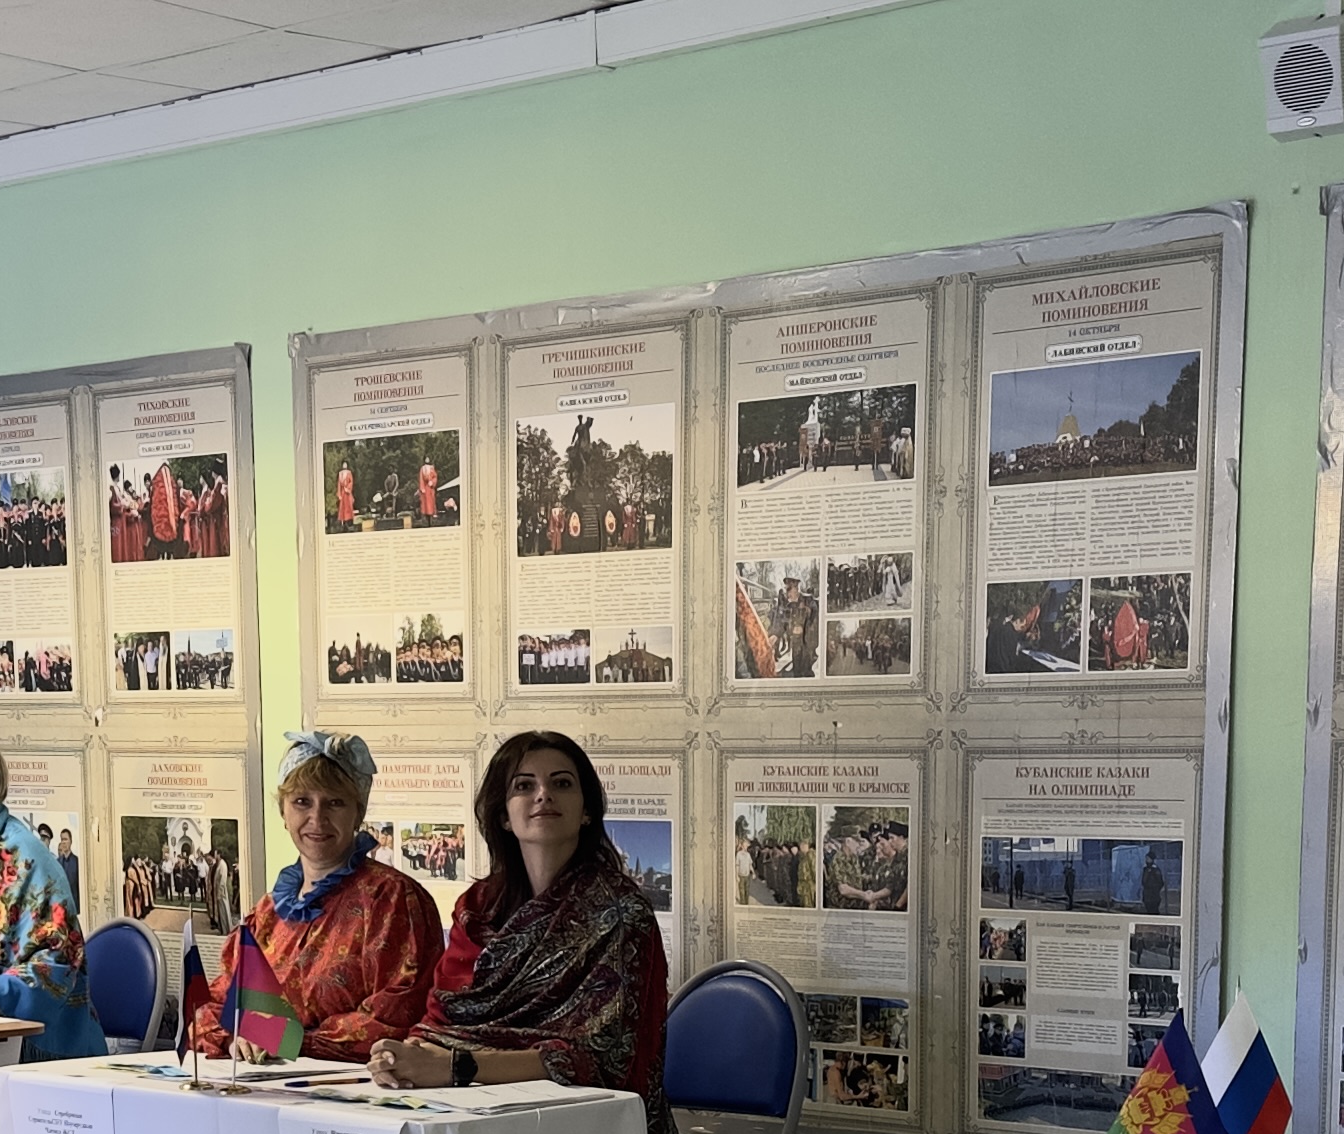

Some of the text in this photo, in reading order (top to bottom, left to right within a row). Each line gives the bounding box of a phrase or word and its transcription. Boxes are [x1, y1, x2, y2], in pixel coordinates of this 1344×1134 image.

[1032, 278, 1161, 306] МИХАЙЛОВСКИЕ
[1042, 299, 1149, 323] ПОМИНОВЕНИЯ
[776, 315, 878, 338] АПШЕРОНСКИЕ
[542, 342, 646, 364] ГРЕЧИШКИНСКИЕ
[780, 333, 872, 354] ПОМИНОВЕНИЯ
[553, 360, 633, 379] ПОМИНОВЕНИЯ
[619, 765, 671, 777] ПЛОЩАДИ
[763, 765, 879, 777] КУБАНСКИЕ КАЗАКИ
[1015, 767, 1150, 779] КУБАНСКИЕ КАЗАКИ
[735, 782, 910, 794] ПРИ ЛИКВИДАЦИИ ЧС В КРЫМСКЕ
[1029, 784, 1136, 798] НА ОЛИМПИАДЕ
